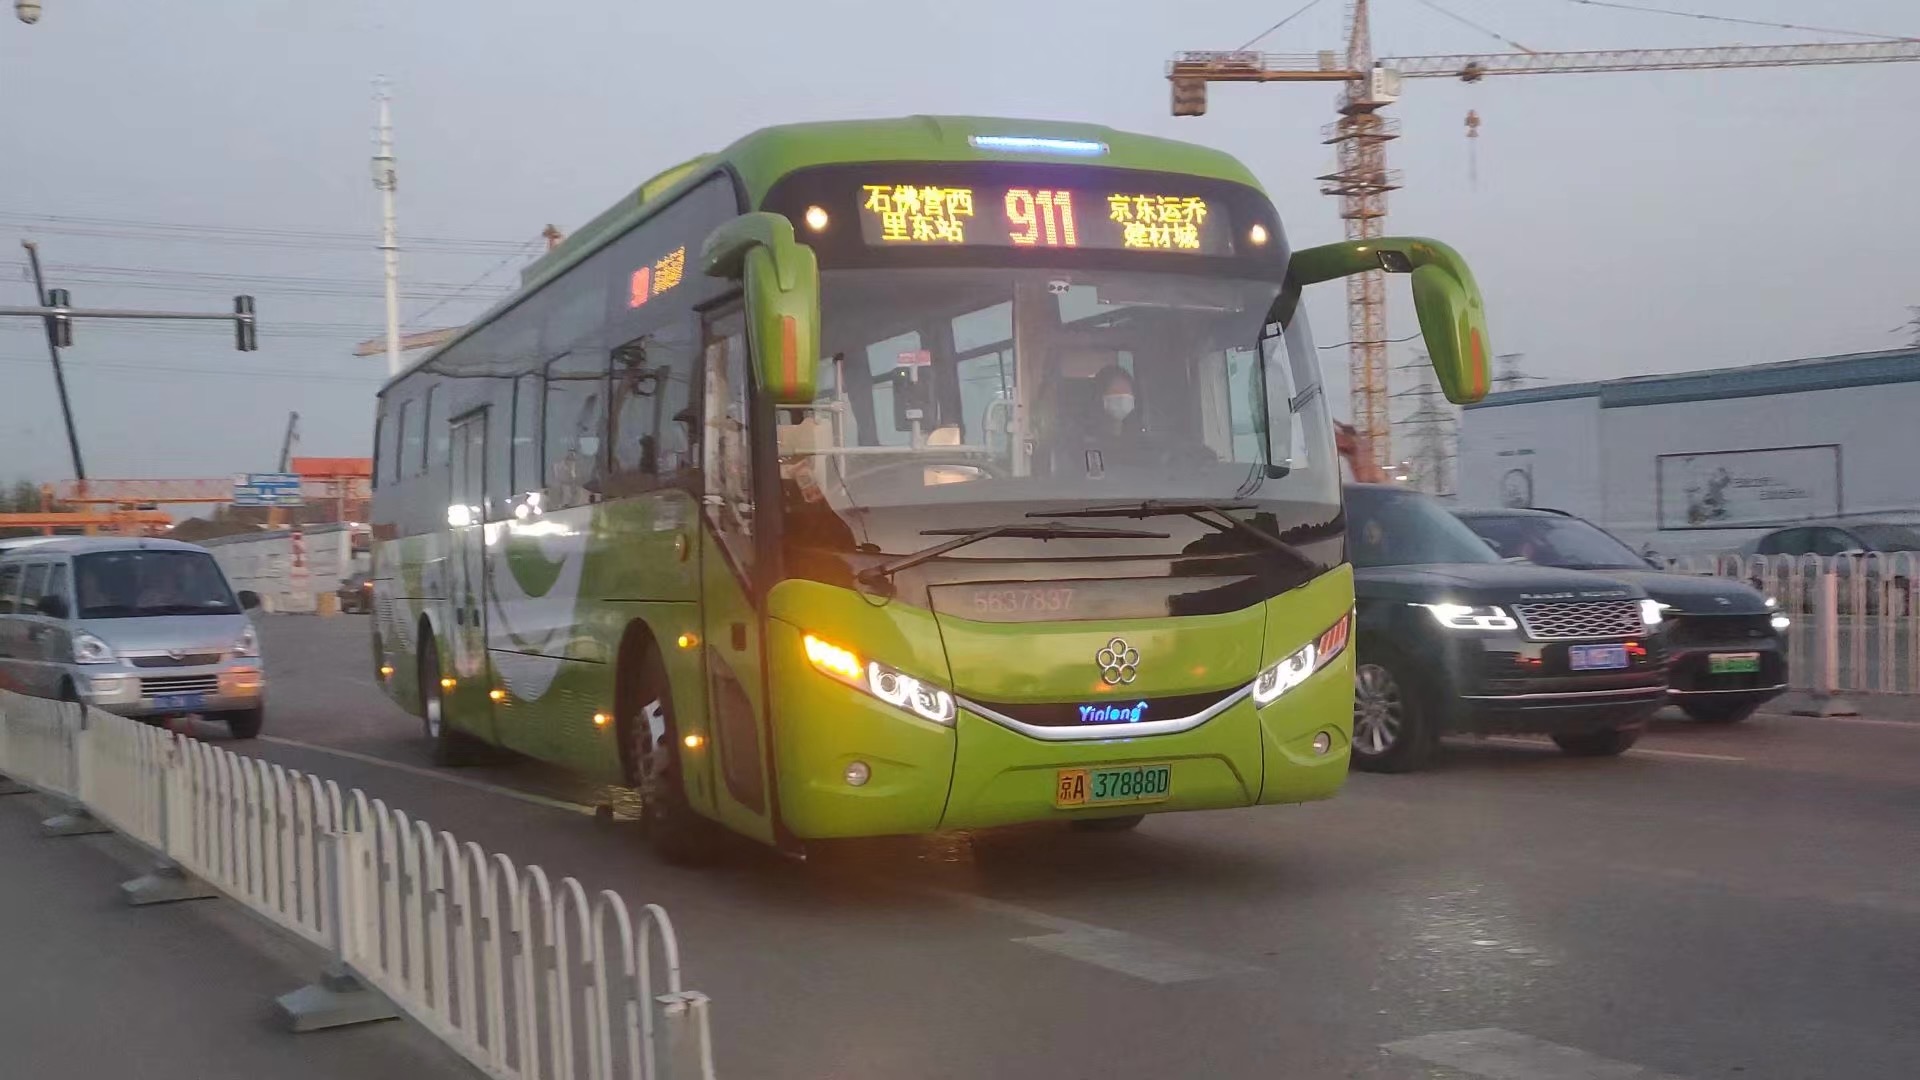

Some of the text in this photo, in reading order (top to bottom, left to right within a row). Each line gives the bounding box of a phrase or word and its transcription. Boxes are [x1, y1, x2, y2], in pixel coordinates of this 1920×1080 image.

[863, 184, 973, 215] 石佛营西
[1107, 193, 1207, 224] 京东运乔
[882, 213, 963, 242] 里东站
[1004, 189, 1076, 245] 911
[1123, 221, 1200, 249] 建材城
[974, 588, 1073, 612] 5637837
[1079, 701, 1142, 723] Yinlong
